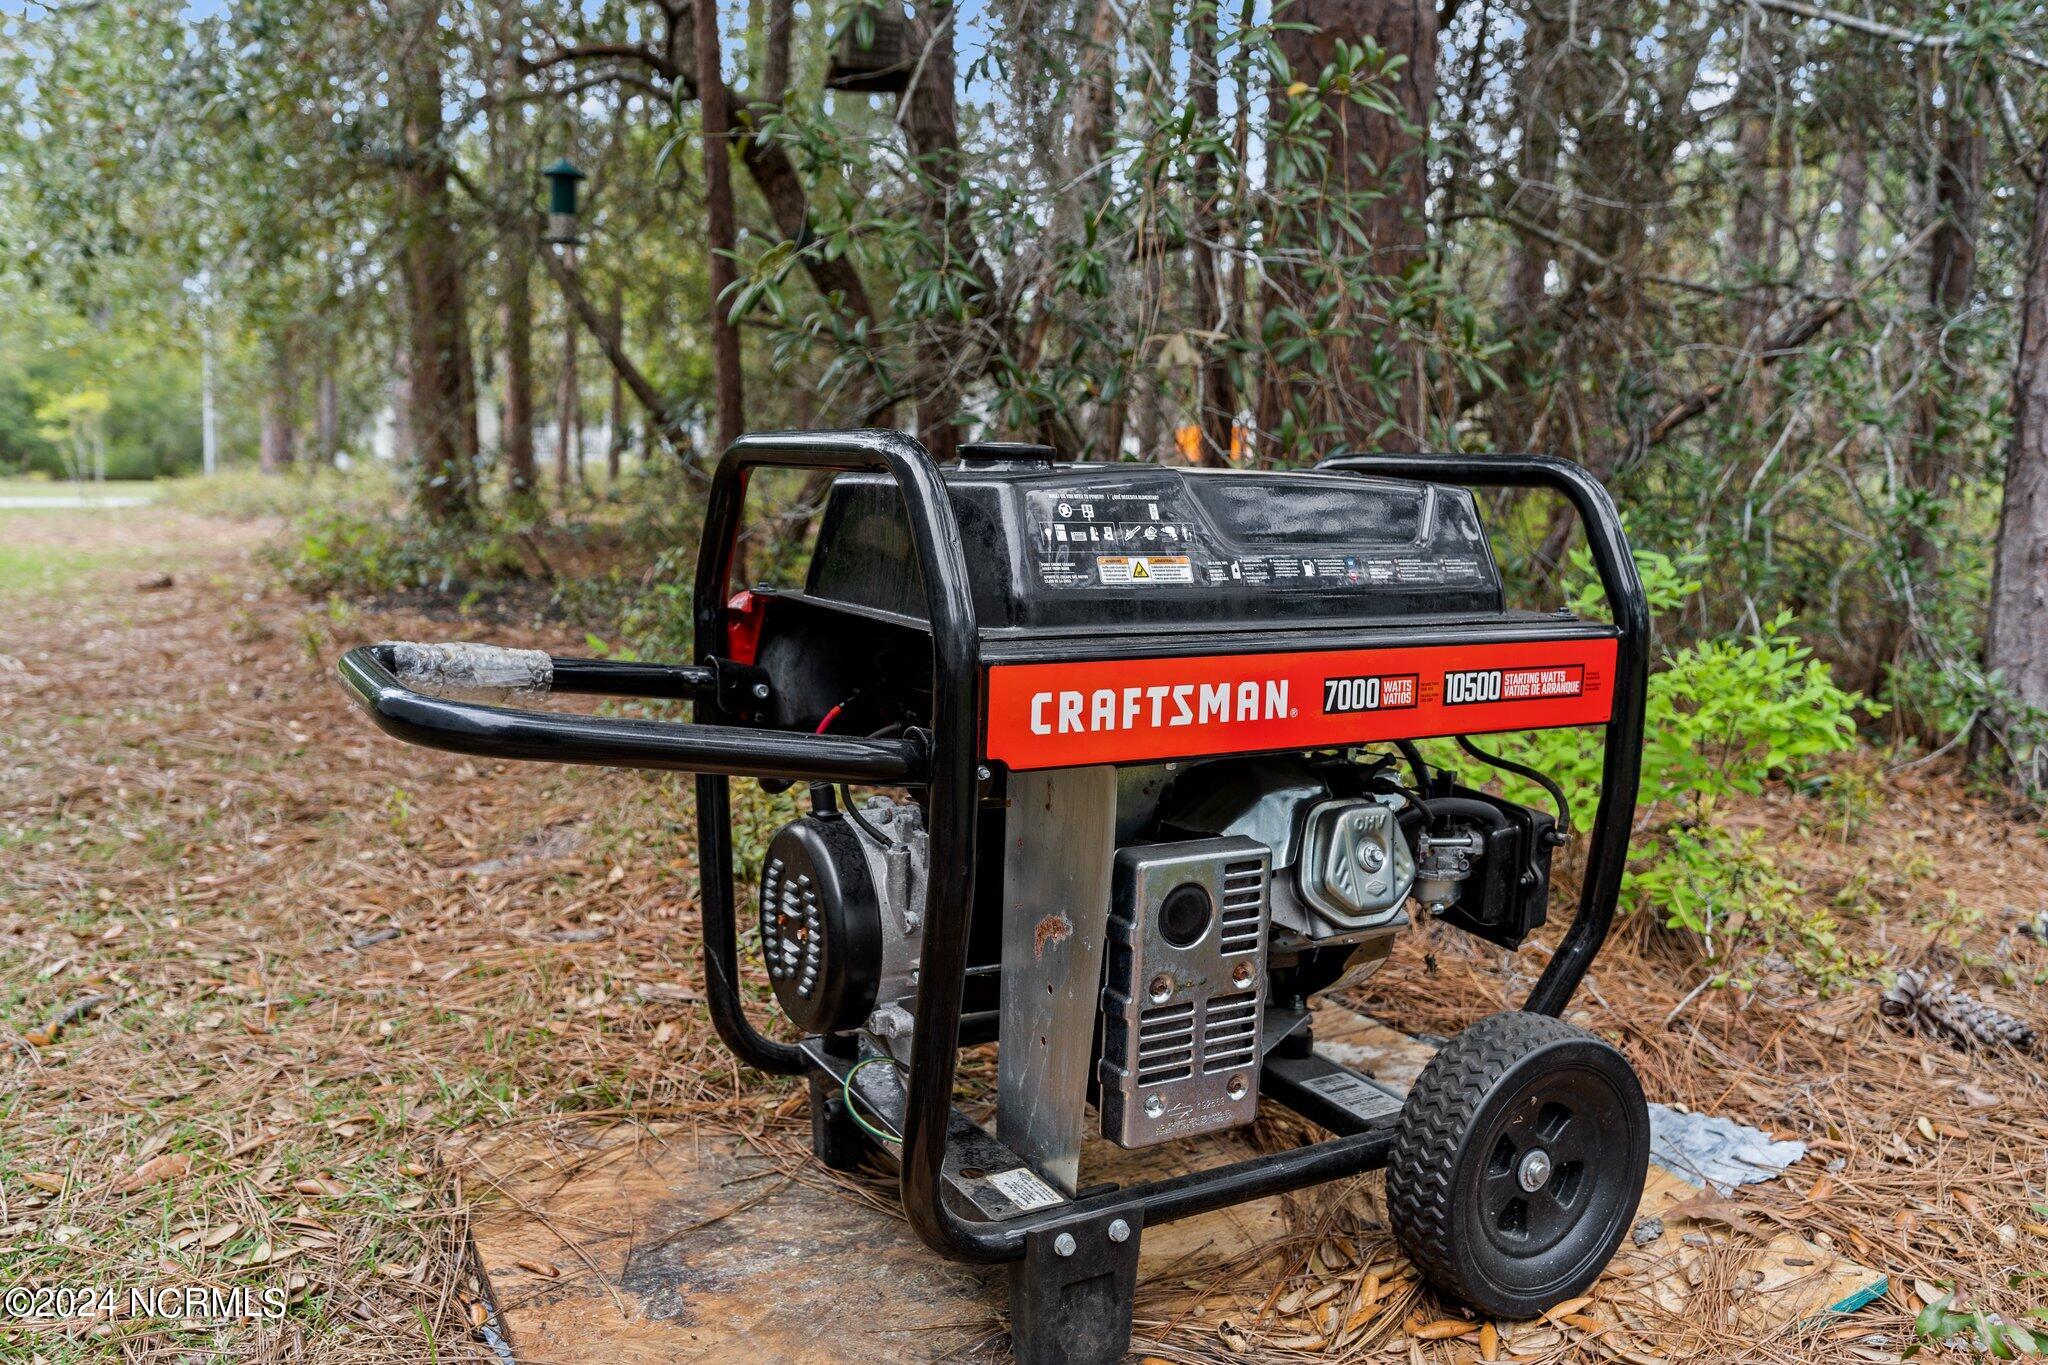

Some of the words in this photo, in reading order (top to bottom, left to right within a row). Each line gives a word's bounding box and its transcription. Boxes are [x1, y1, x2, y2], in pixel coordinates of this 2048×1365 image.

[1383, 679, 1412, 693] WATTS
[1445, 671, 1501, 703] 10500
[1504, 672, 1539, 686] STARTING
[1541, 671, 1565, 683] WATTS
[1325, 678, 1380, 712] 7000
[1504, 684, 1530, 697] VATIOS
[1531, 683, 1540, 695] DE
[1541, 681, 1580, 695] ARRANQUE
[1383, 692, 1412, 705] VATIOS
[1030, 679, 1289, 736] CRAFTSMAN
[1353, 814, 1386, 832] OHV
